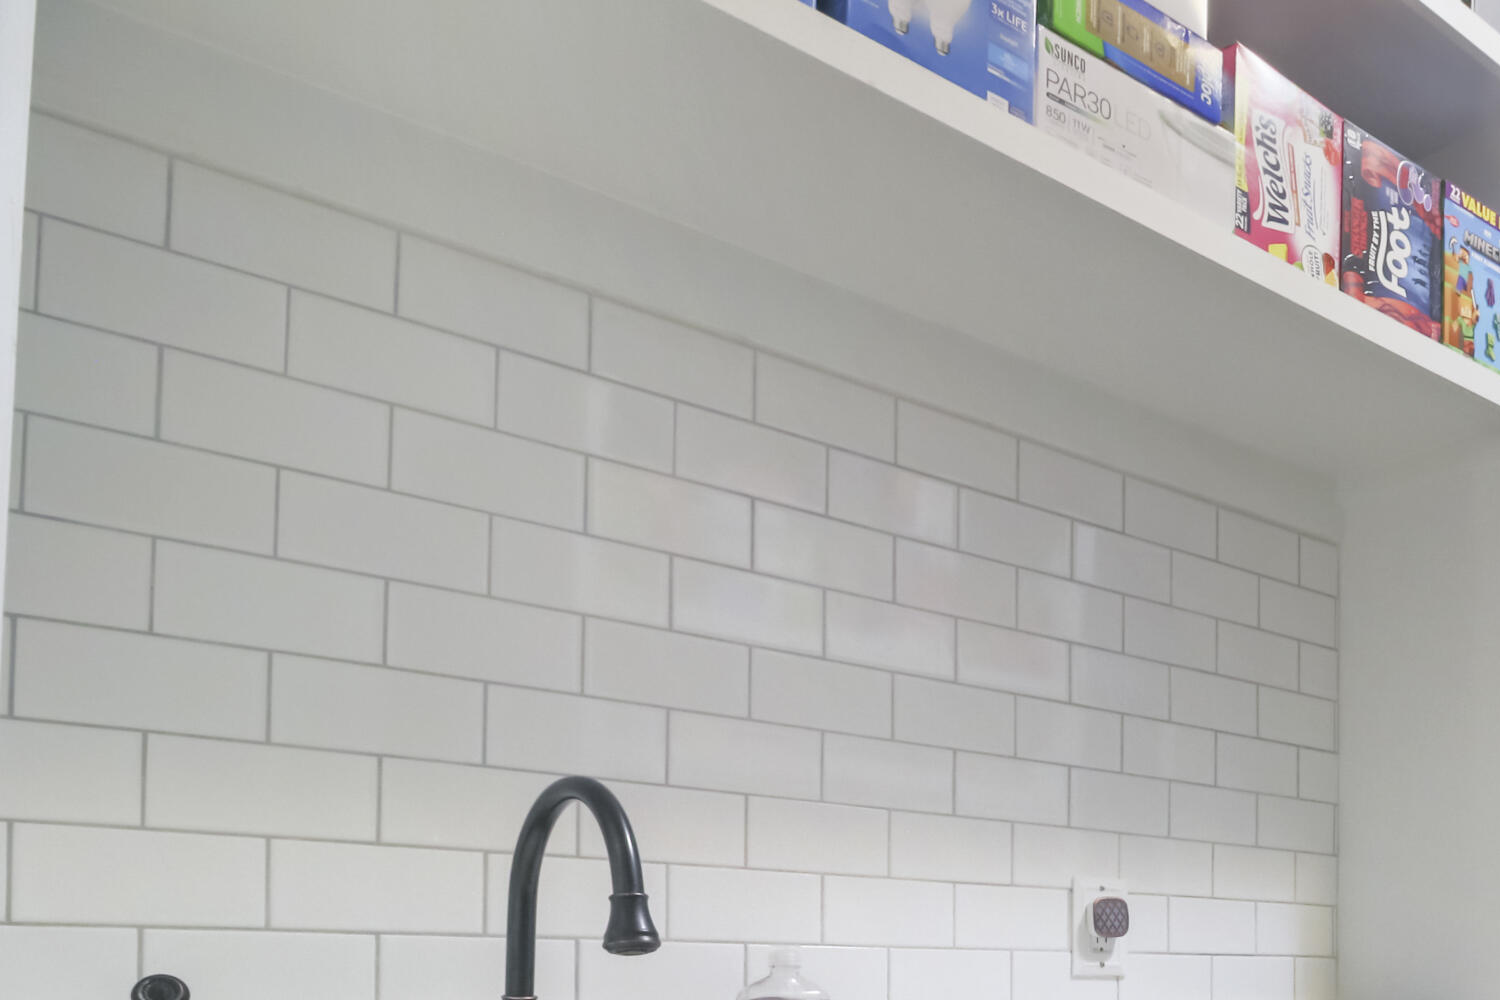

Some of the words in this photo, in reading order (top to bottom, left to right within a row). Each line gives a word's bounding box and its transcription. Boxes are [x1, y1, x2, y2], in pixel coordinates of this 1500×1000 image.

[991, 2, 1004, 18] 3x
[1006, 11, 1028, 33] LIFE
[1054, 44, 1086, 74] SUNCO
[1046, 68, 1112, 120] PAR30
[1114, 104, 1151, 141] LED
[1046, 104, 1066, 124] 850
[1254, 114, 1291, 226] Welch's
[1371, 210, 1380, 231] THE
[1450, 185, 1461, 200] 22
[1462, 192, 1497, 226] VALUE
[1235, 213, 1245, 230] 22
[1303, 200, 1316, 242] Fruit
[1371, 231, 1380, 245] BY
[1376, 207, 1412, 298] Foot
[1369, 244, 1380, 272] FRUIT
